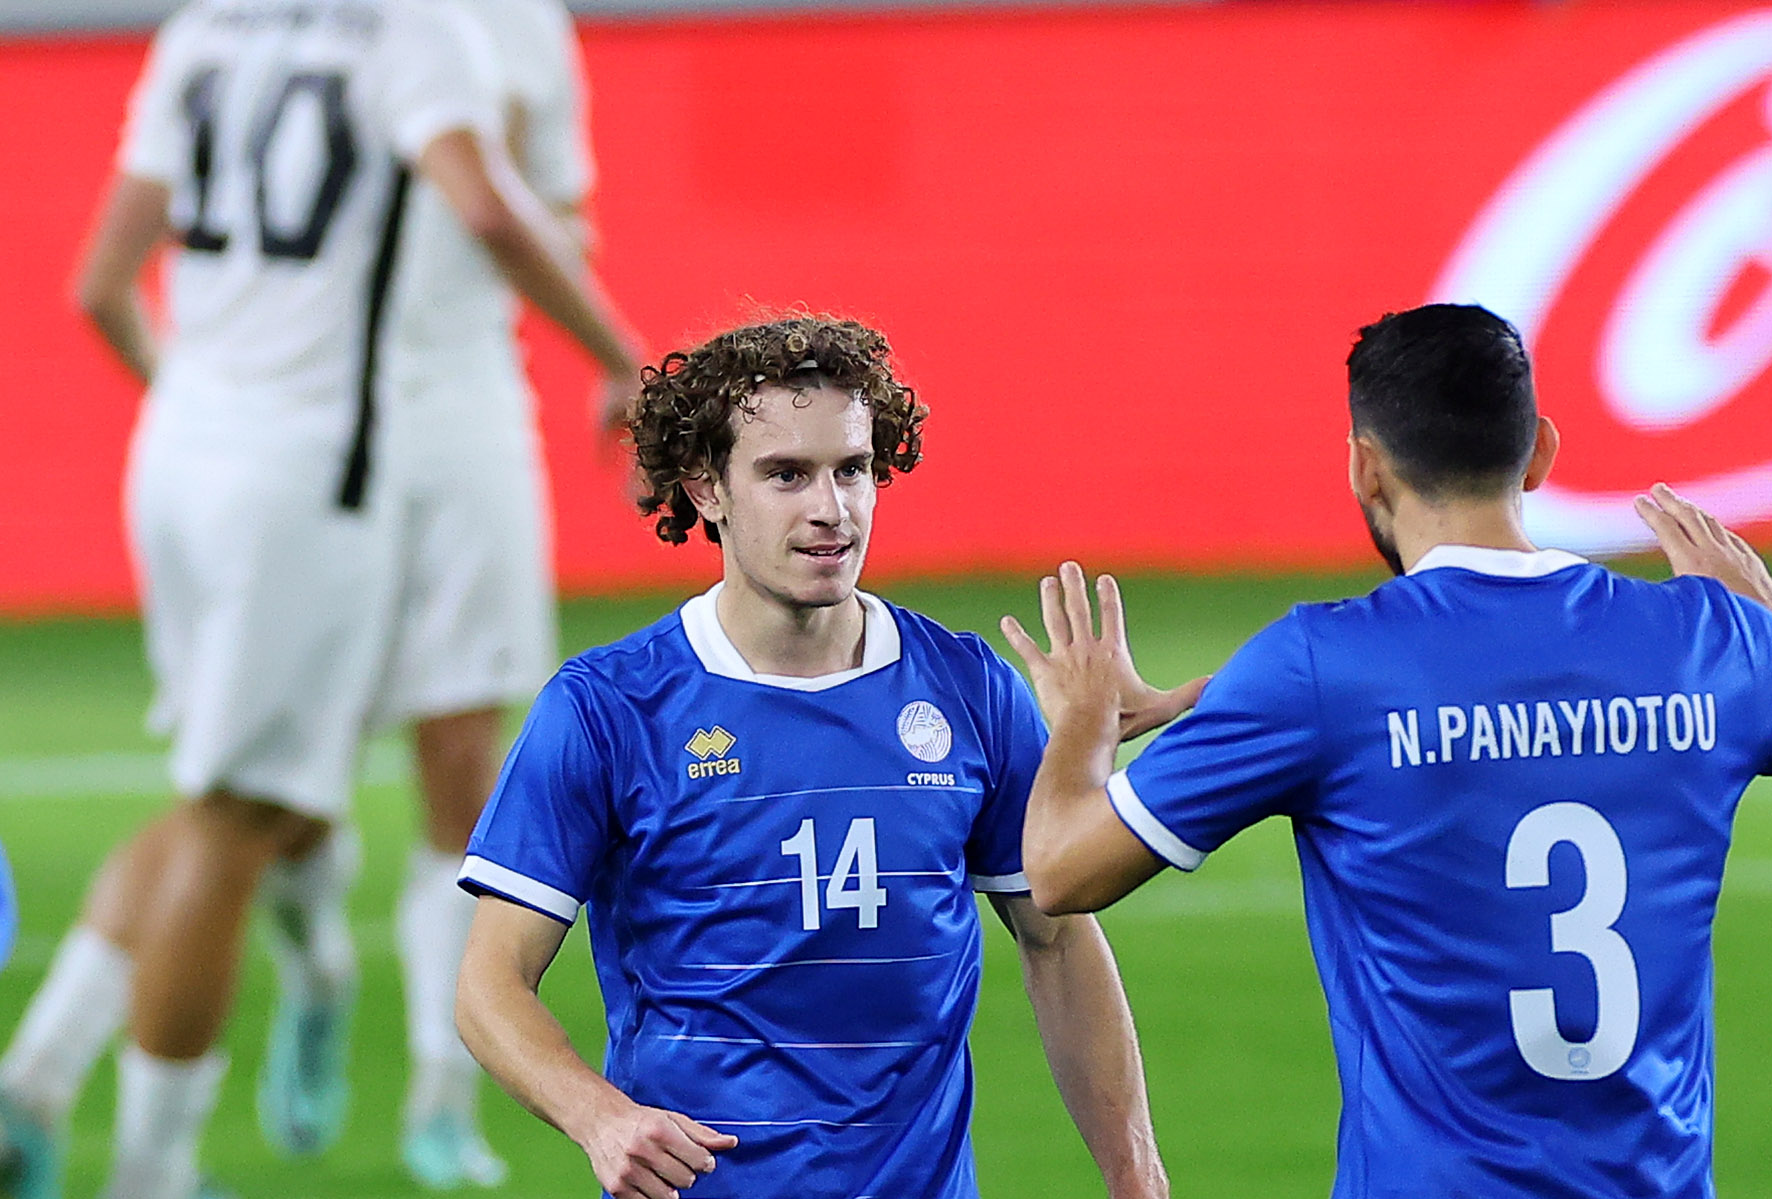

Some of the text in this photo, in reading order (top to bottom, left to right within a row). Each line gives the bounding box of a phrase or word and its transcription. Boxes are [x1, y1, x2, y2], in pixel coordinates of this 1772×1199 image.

[178, 66, 360, 260] 10
[906, 772, 956, 786] CYPRUS
[1386, 692, 1717, 768] N.PANAYIOTOU
[780, 816, 888, 931] 14
[1505, 800, 1641, 1081] 3
